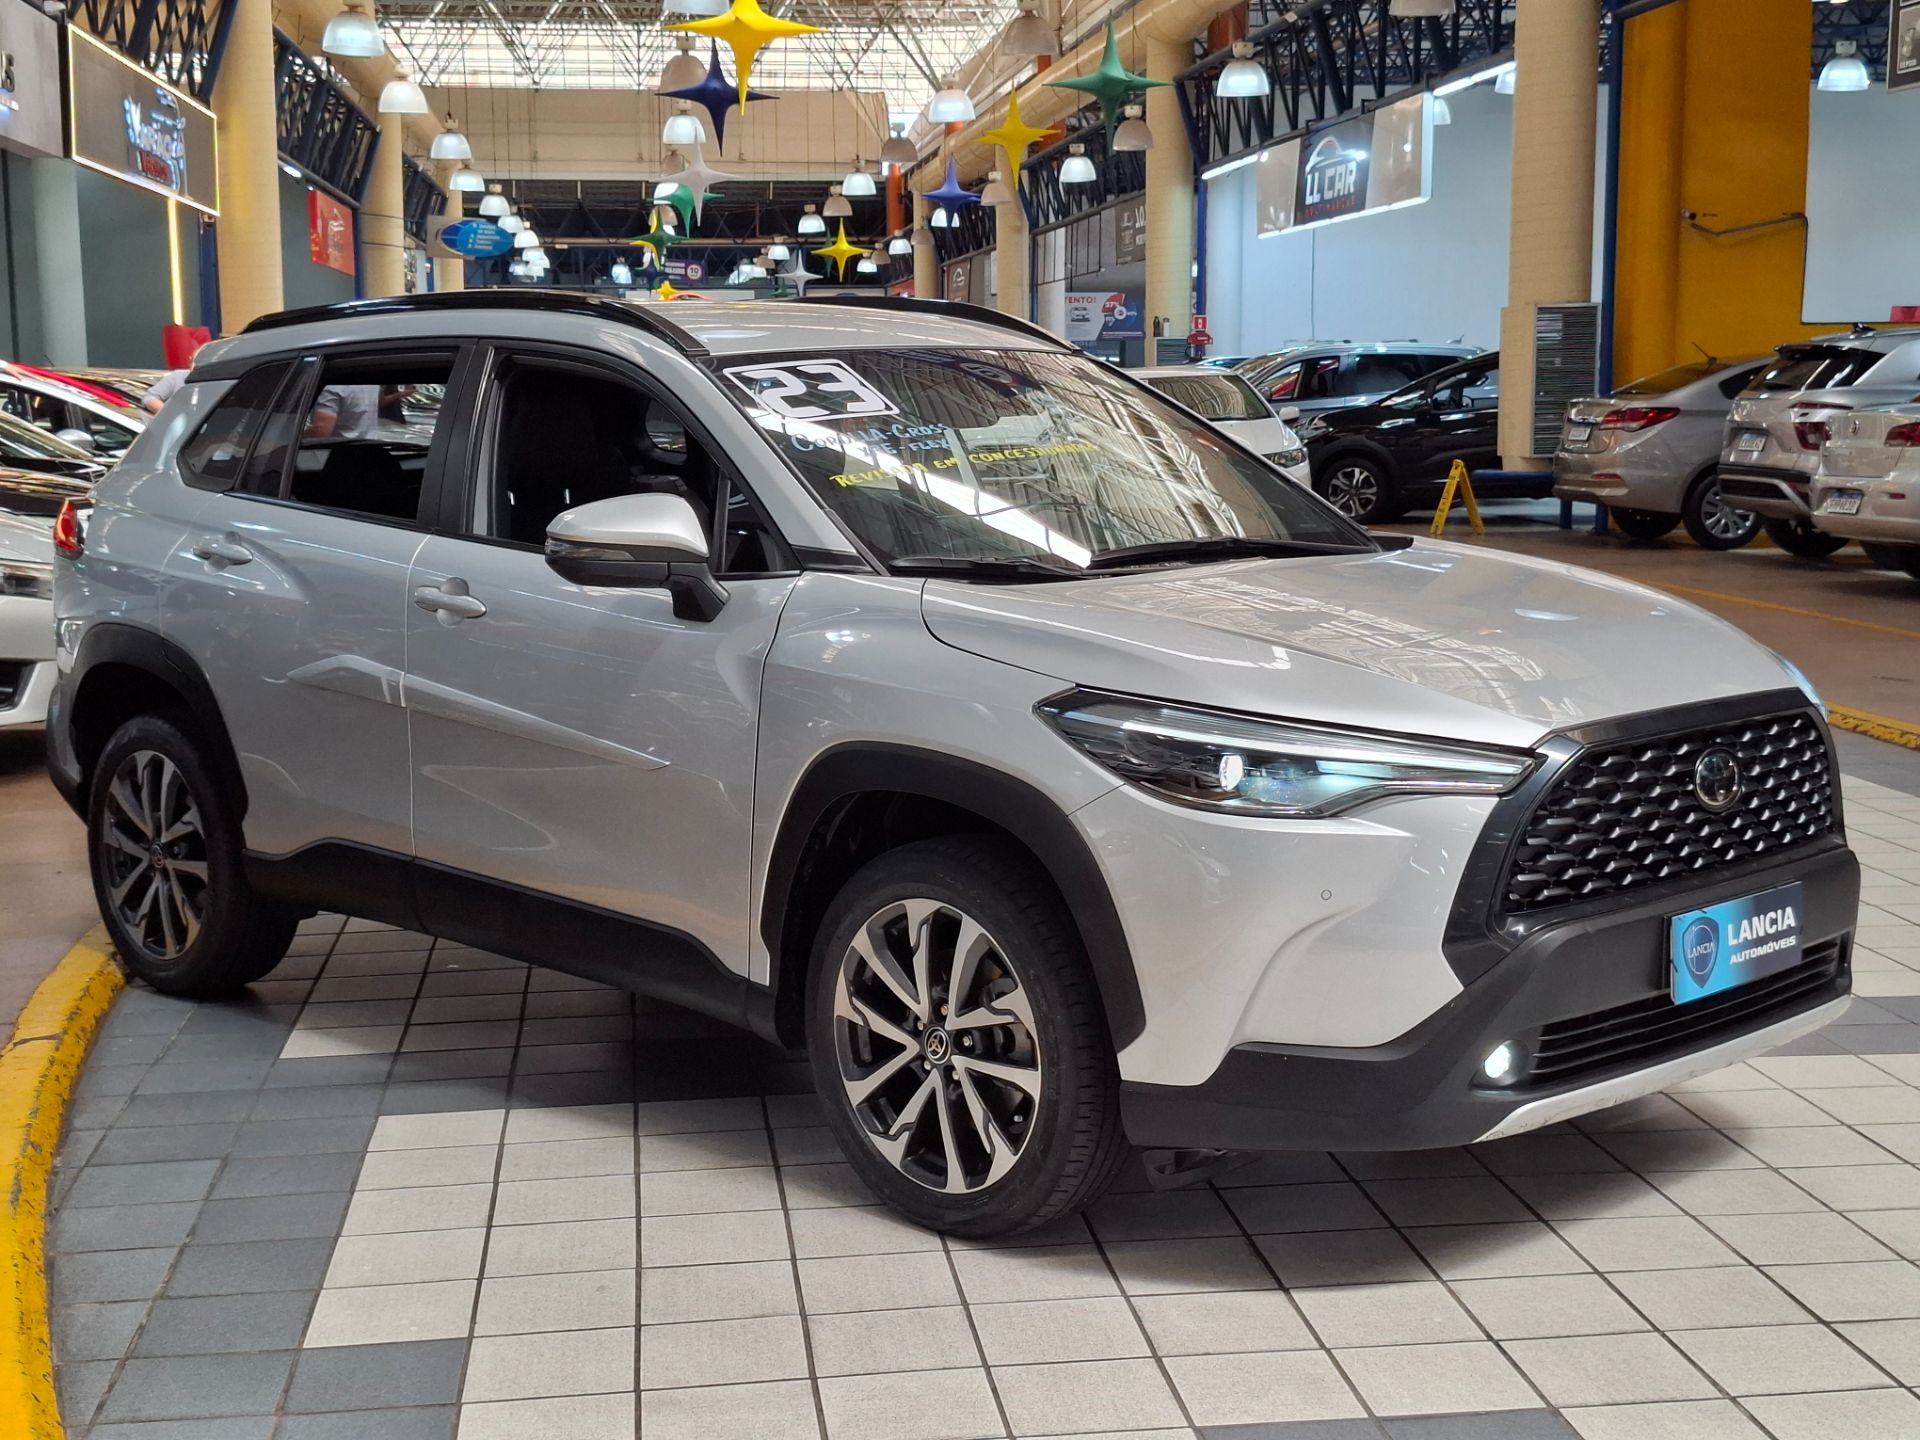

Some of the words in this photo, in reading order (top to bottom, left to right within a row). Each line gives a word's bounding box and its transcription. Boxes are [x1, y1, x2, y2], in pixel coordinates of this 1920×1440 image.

[1305, 173, 1321, 205] LL
[1323, 160, 1357, 200] CAR
[741, 364, 870, 418] 23
[1728, 906, 1796, 946] LANCIA
[1687, 941, 1715, 959] LANCIA
[1729, 936, 1796, 965] AUTOMÓVEIS
